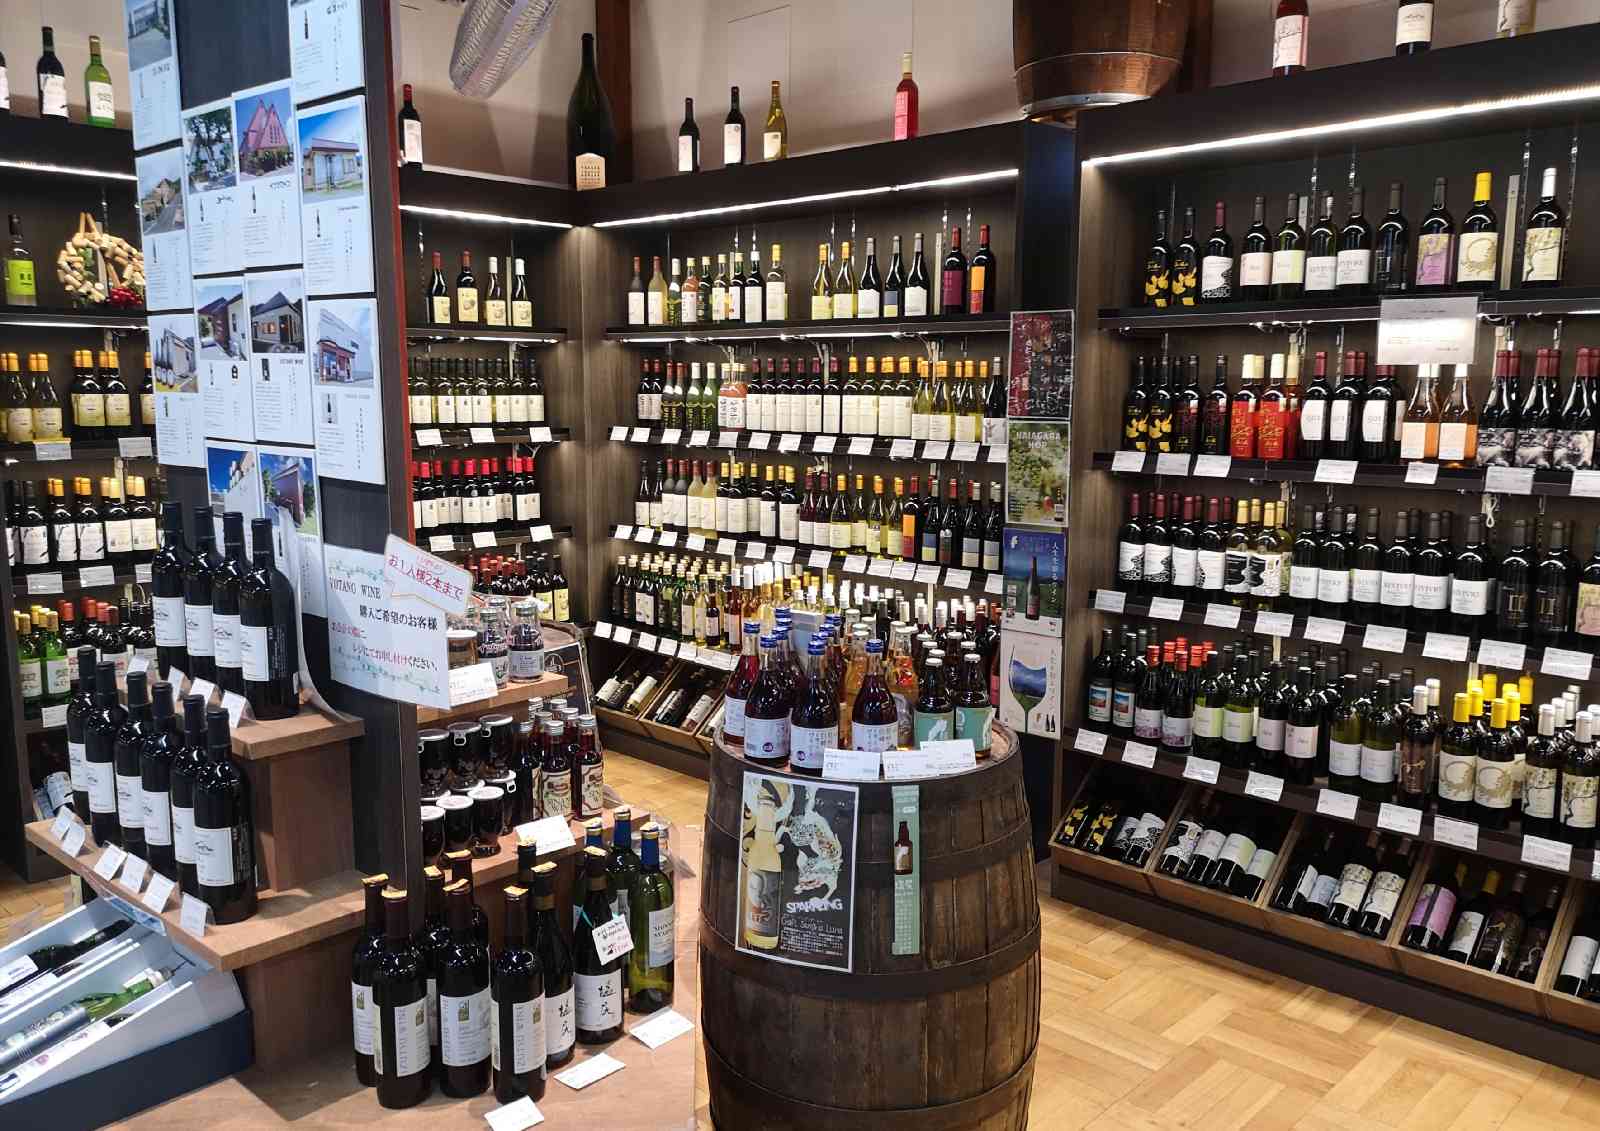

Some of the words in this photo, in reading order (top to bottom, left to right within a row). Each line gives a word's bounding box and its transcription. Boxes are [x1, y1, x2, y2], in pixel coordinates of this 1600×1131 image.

[361, 584, 381, 599] WINE
[359, 605, 438, 631] 購入ご希望のお客様
